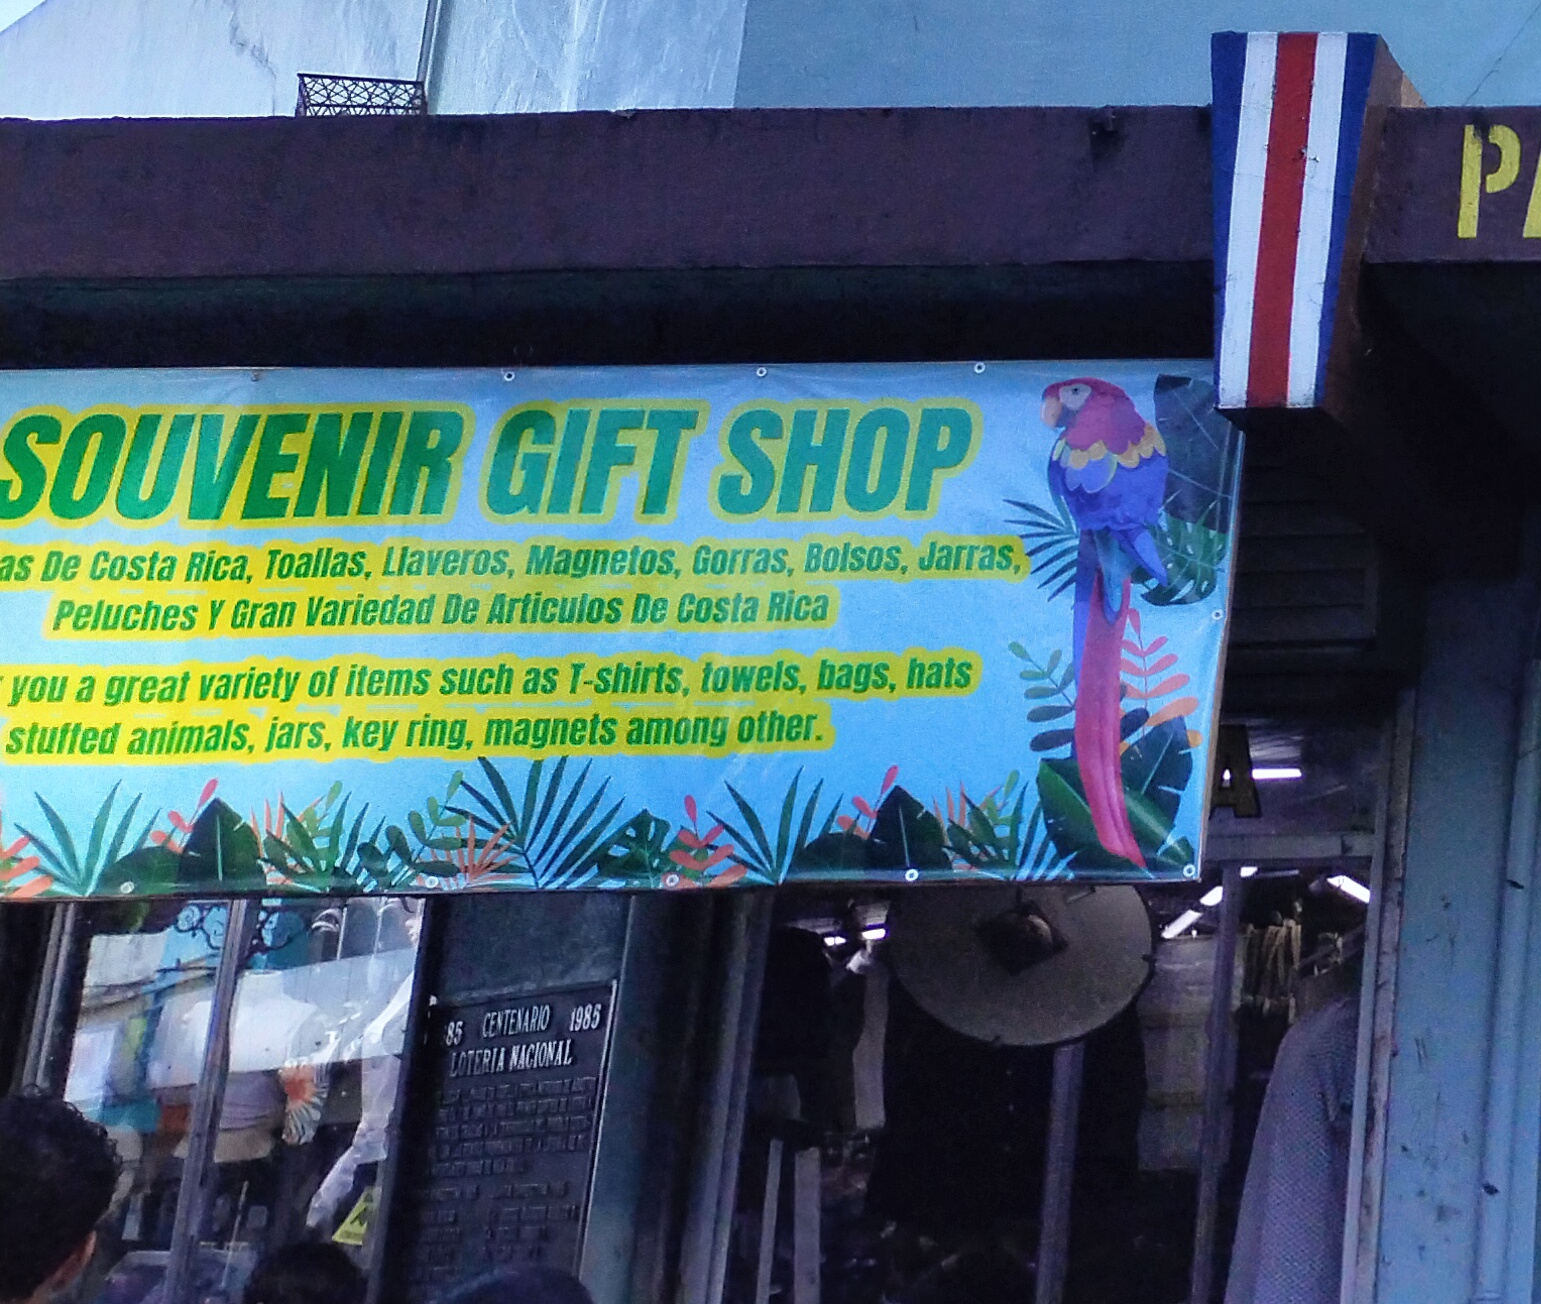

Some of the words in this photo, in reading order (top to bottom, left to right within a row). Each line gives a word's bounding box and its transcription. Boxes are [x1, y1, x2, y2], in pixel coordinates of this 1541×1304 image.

[0, 409, 466, 522] SOUVENIR
[486, 407, 699, 517] GIFT
[717, 406, 974, 515] SHOP
[41, 551, 81, 582] De
[90, 551, 178, 581] Costa
[185, 550, 254, 584] Rica,
[266, 547, 372, 581] Toallas,
[383, 545, 515, 580] Llaveros,
[525, 544, 683, 579] Magnetos,
[692, 544, 794, 577] Gorras,
[804, 541, 908, 577] Bolsos,
[919, 539, 1022, 576] Jarras,
[53, 600, 198, 630] Peluches
[209, 600, 228, 630] Y
[231, 598, 294, 628] Gran
[306, 594, 436, 627] Variedad
[442, 593, 480, 625] De
[486, 592, 624, 624] Articulos
[631, 593, 669, 623] De
[677, 592, 760, 623] Costa
[766, 590, 829, 621] Rica
[7, 676, 68, 706] you
[75, 676, 96, 702] a
[104, 670, 191, 706] great
[199, 666, 302, 705] variety
[308, 665, 338, 698] of
[346, 663, 431, 696] items
[440, 663, 514, 696] such
[523, 668, 558, 695] as
[570, 661, 689, 698] T-shirts,
[702, 659, 807, 695] towels,
[818, 657, 897, 693] bags,
[907, 657, 973, 689] hats
[6, 722, 121, 754] stuffed
[128, 719, 256, 756] animals,
[265, 717, 333, 754] jars,
[343, 716, 399, 752] key
[406, 715, 473, 752] ring,
[485, 713, 618, 748] magnets
[626, 714, 730, 748] among
[738, 711, 824, 745] other.
[482, 1003, 552, 1038] CENTENARIO
[569, 1003, 604, 1033] 1985
[449, 1046, 506, 1078] LOTERIA
[509, 1039, 574, 1072] NACIONAL
